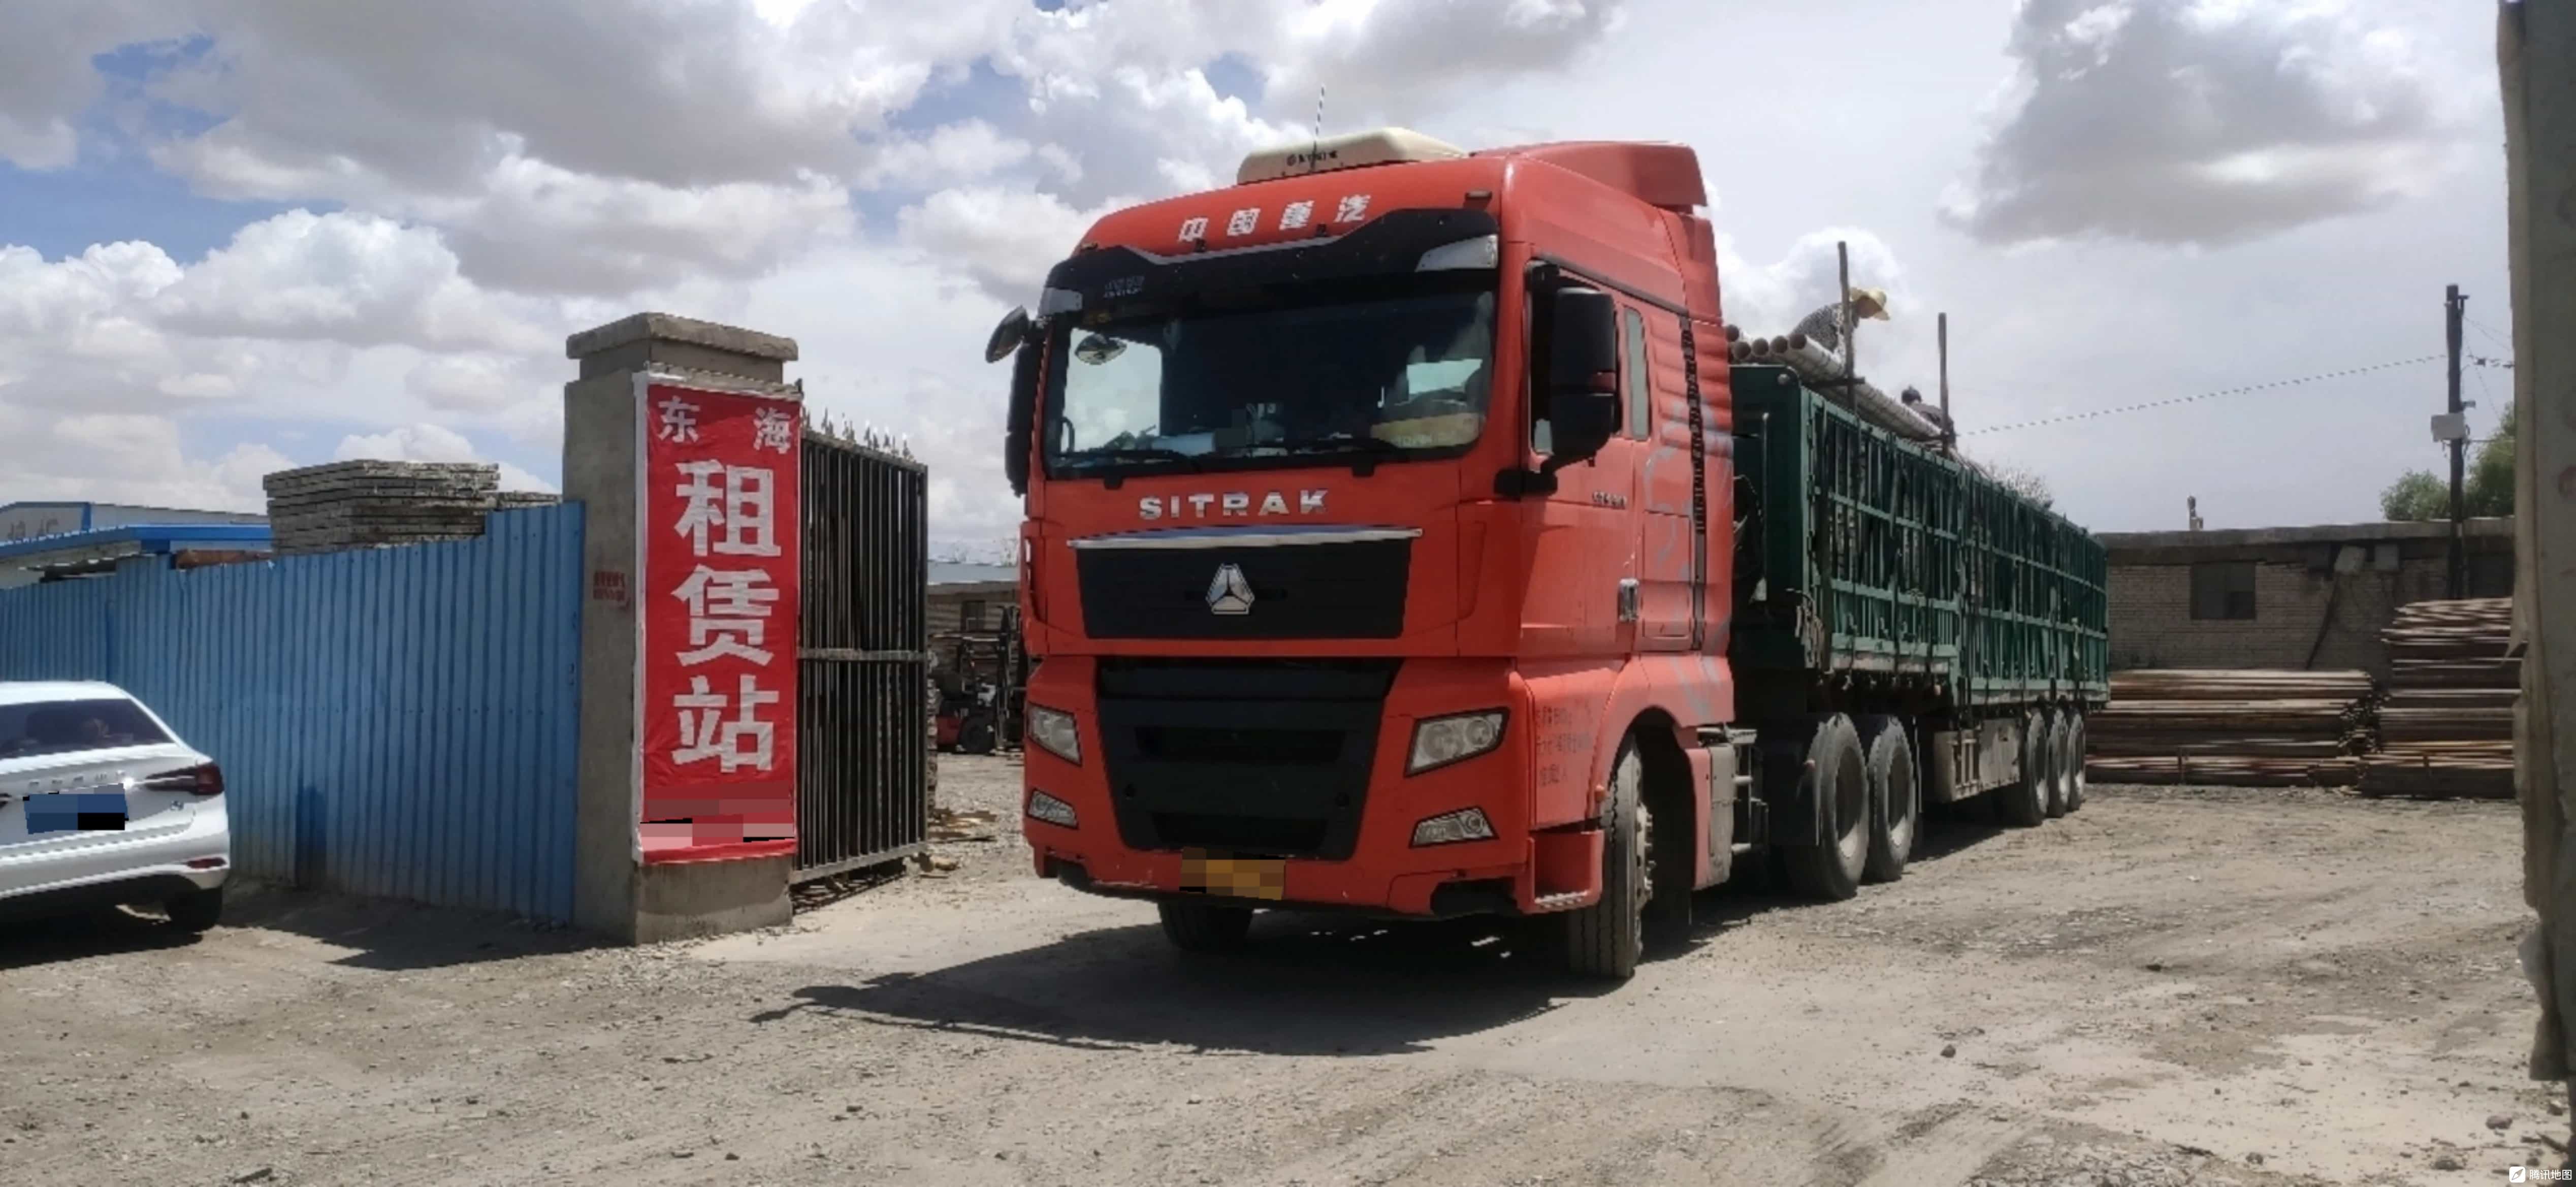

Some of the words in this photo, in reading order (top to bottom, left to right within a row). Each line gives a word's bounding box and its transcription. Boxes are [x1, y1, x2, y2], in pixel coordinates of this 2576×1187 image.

[658, 395, 791, 454] 东海
[1139, 489, 1329, 520] SITRAK
[670, 459, 782, 773] 租赁站
